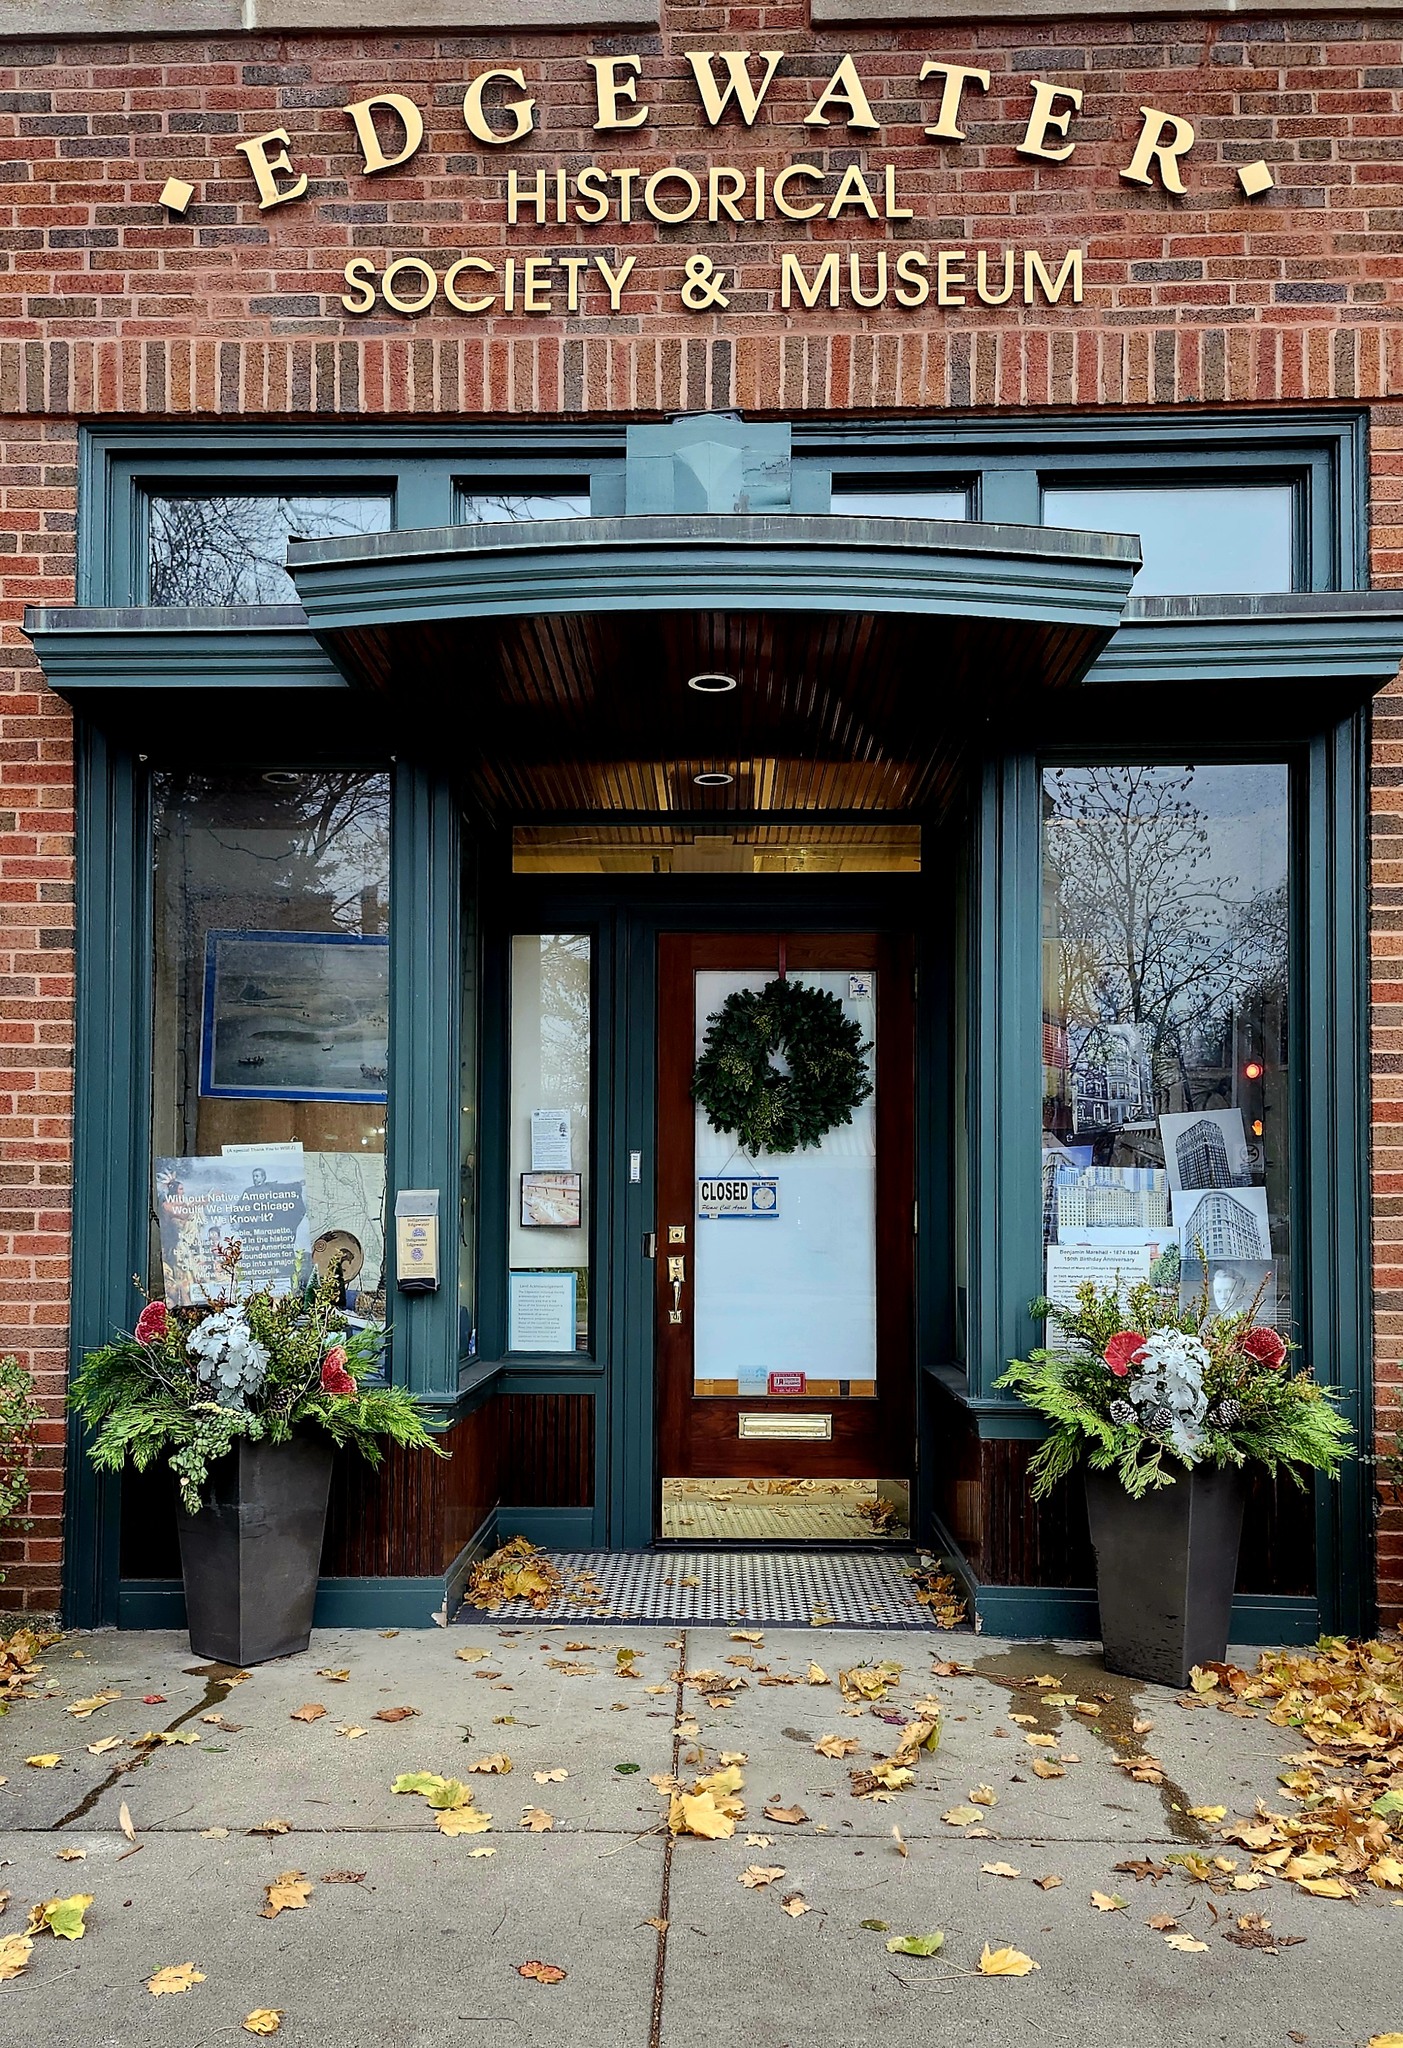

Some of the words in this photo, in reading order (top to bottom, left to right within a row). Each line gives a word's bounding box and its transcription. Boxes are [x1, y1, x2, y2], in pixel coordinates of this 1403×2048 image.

[235, 50, 1196, 211] EDGEWATER
[507, 164, 914, 225] HISTORICAL
[341, 256, 637, 314] SOCIETY
[680, 254, 731, 311] &
[781, 248, 1085, 310] MUSEUM
[165, 1194, 205, 1204] Without
[207, 1193, 240, 1202] Native
[242, 1190, 300, 1201] Americans,
[702, 1182, 749, 1201] CLOSED
[172, 1205, 204, 1215] Would
[206, 1205, 223, 1214] We
[225, 1204, 251, 1213] Have
[253, 1201, 295, 1212] Chicago
[195, 1216, 209, 1226] As
[211, 1215, 227, 1225] We
[229, 1214, 258, 1224] Know
[259, 1213, 274, 1222] It?
[269, 1234, 295, 1244] history
[241, 1251, 281, 1261] foundation
[281, 1250, 294, 1258] for
[252, 1260, 266, 1268] into
